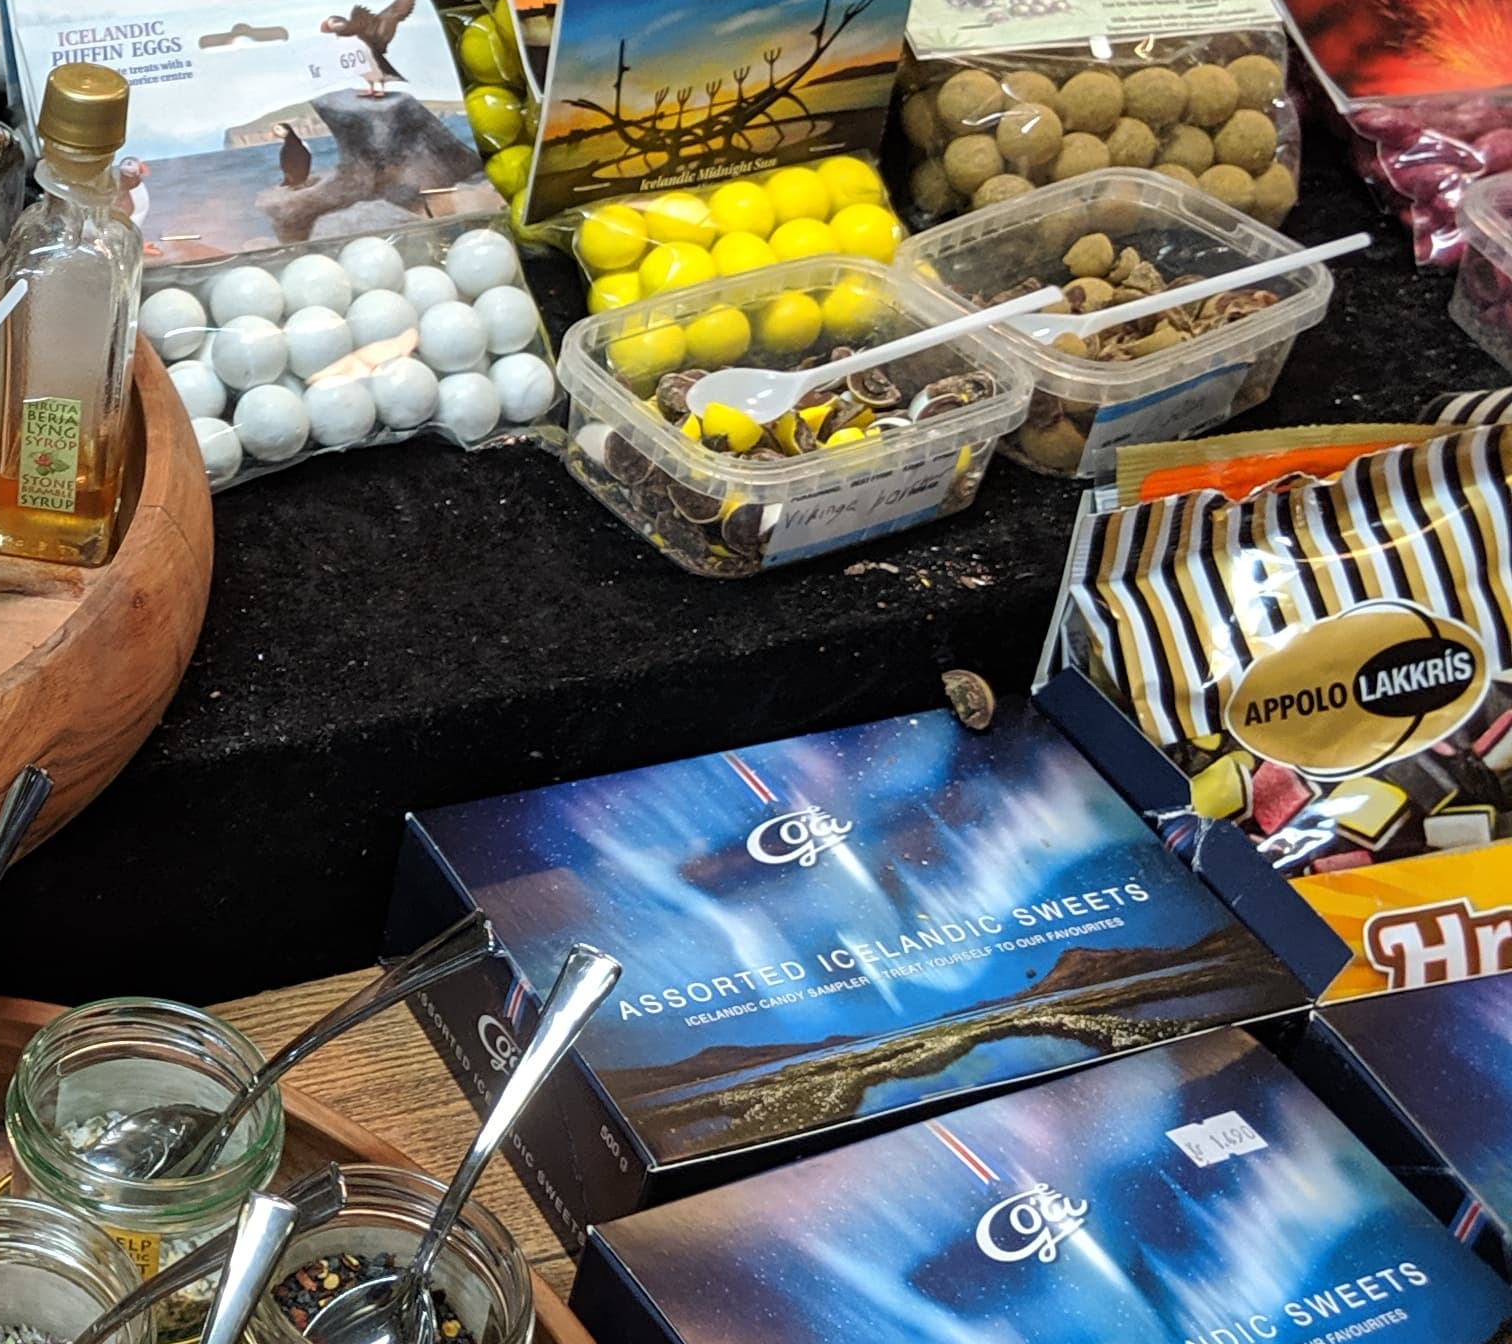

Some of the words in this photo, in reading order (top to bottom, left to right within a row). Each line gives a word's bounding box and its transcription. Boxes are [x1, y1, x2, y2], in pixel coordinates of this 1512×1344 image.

[58, 21, 164, 47] ICELANDIC
[52, 44, 123, 66] PUFFIN
[132, 37, 182, 57] EGGS
[340, 50, 367, 69] 690
[129, 65, 159, 75] treats
[160, 60, 183, 70] with
[160, 71, 193, 81] centre
[640, 171, 696, 191] Icelandic
[697, 161, 752, 180] Midnight
[753, 158, 778, 170] Sun
[28, 410, 77, 426] BERJA
[28, 422, 75, 438] LYNG
[22, 474, 73, 489] STONE
[22, 486, 73, 498] BRAMBLE
[21, 495, 74, 509] SYRUP
[1245, 682, 1347, 726] APPOLO
[1358, 649, 1472, 703] LAKKRÍS
[618, 960, 806, 1021] ASSORTED
[818, 914, 1002, 973] ICELANDIC
[1011, 881, 1150, 928] SWEETS
[685, 1002, 757, 1027] ICELANDIC
[759, 990, 806, 1014] CANDY
[809, 976, 870, 999] SAMPLER
[883, 963, 924, 982] TREAT
[924, 946, 994, 971] YOURSELF
[995, 939, 1014, 954] TO
[1016, 932, 1044, 950] OUR
[1046, 916, 1125, 943] FAVOURITES
[600, 1125, 620, 1154] 500
[538, 1170, 587, 1246] SWEETS
[1285, 1262, 1429, 1327] SWEETS
